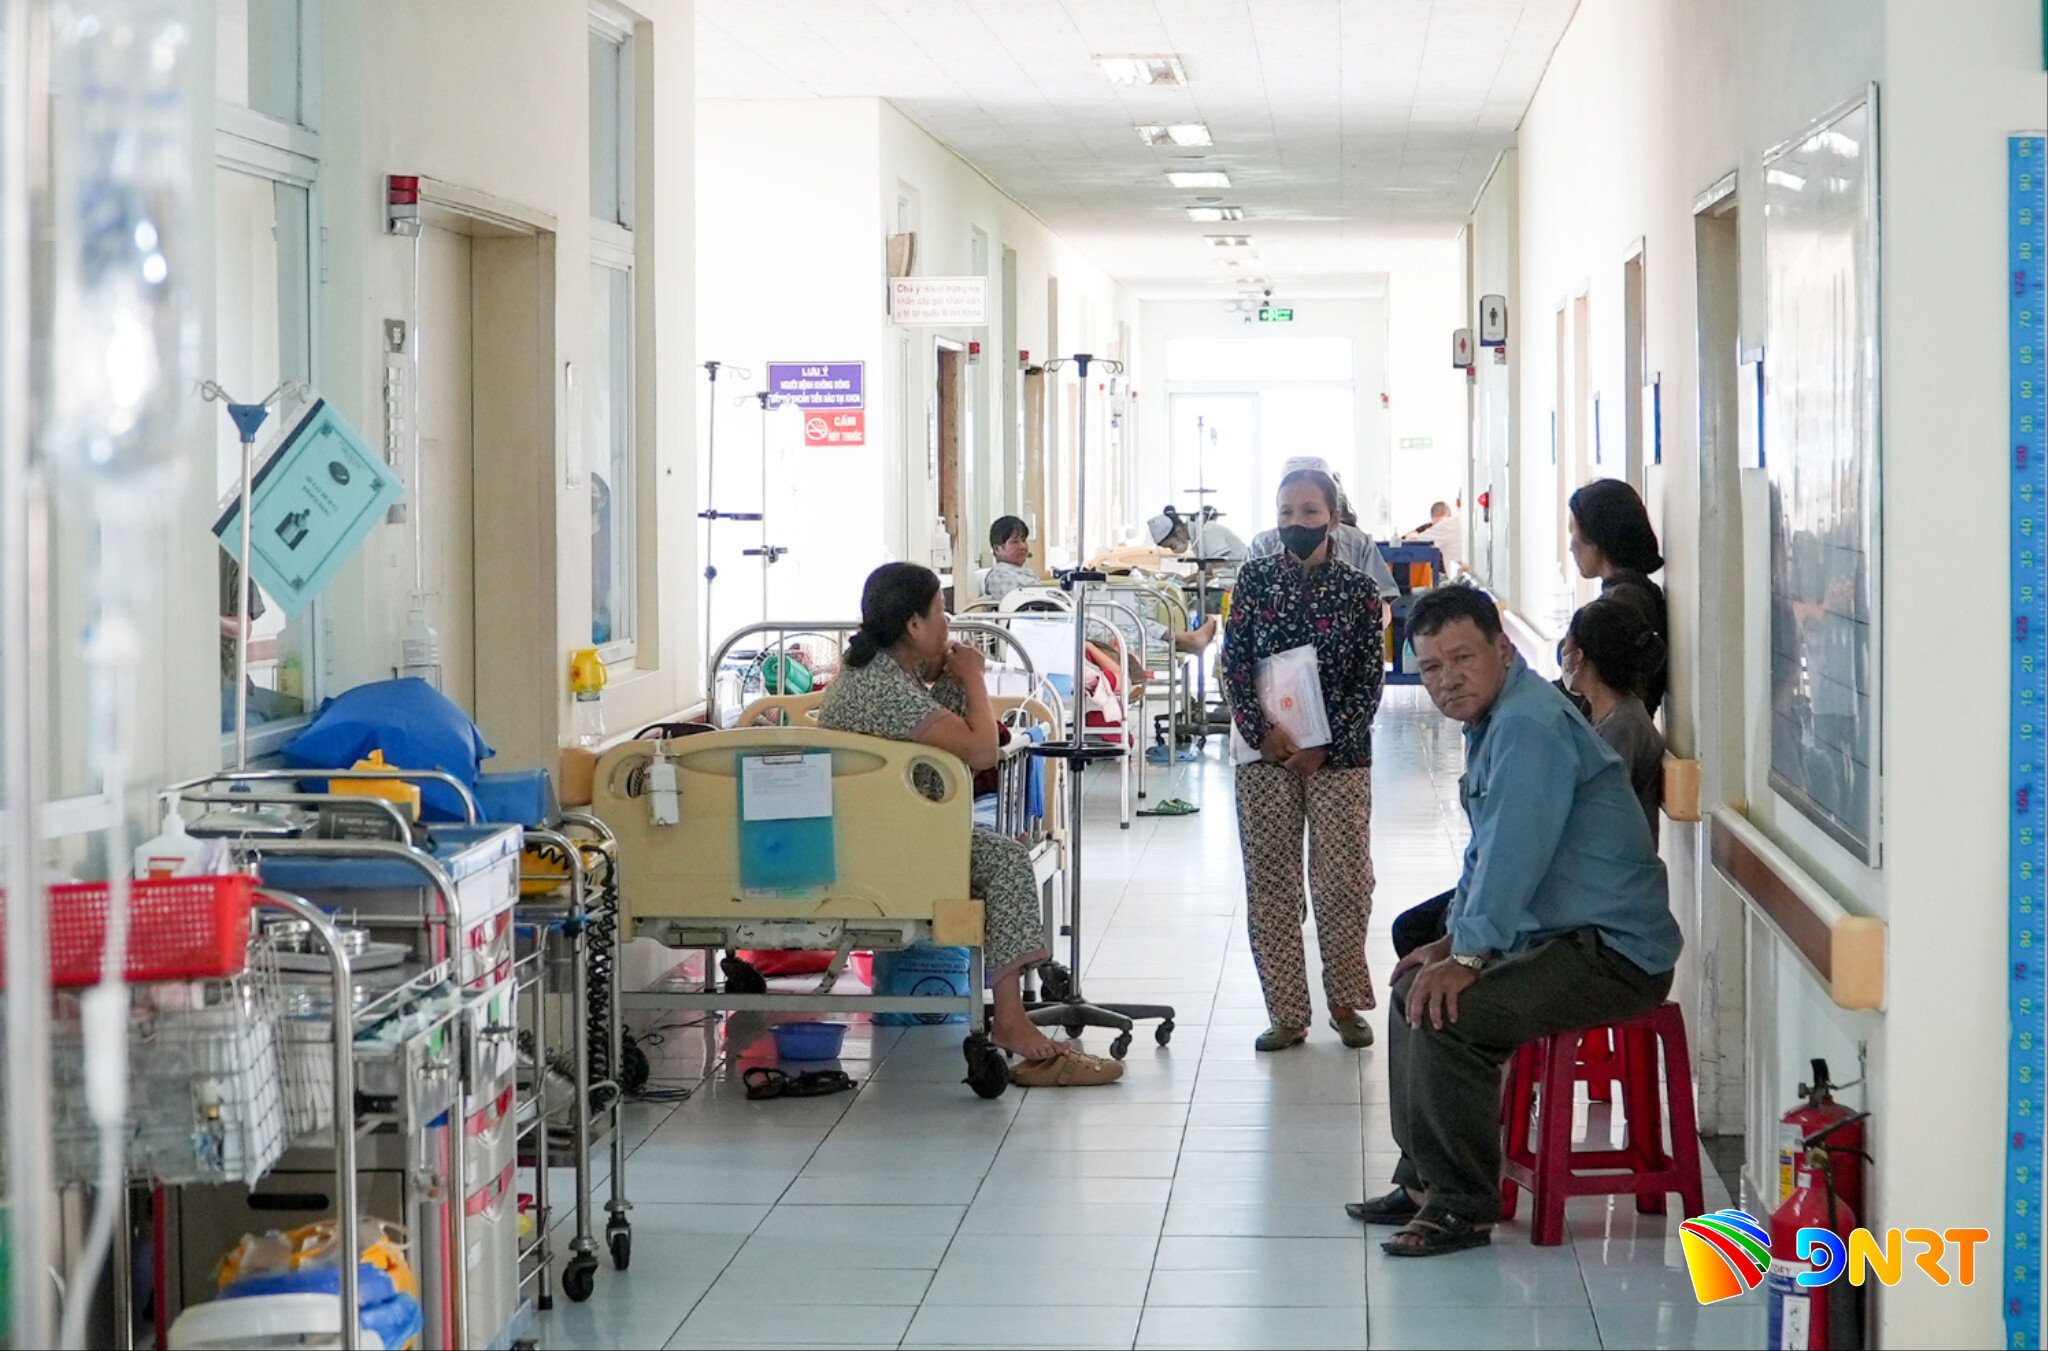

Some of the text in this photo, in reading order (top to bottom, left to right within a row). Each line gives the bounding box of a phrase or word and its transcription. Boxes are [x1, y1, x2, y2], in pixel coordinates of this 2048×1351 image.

[2020, 140, 2032, 158] 95
[2020, 174, 2032, 192] 90
[2020, 208, 2032, 226] 85
[2020, 242, 2032, 260] 80
[2015, 271, 2026, 297] 175
[2020, 311, 2032, 328] 70
[2020, 346, 2033, 364] 65
[2020, 381, 2033, 399] 60
[834, 413, 857, 427] CẤM
[2021, 416, 2033, 433] 55
[2016, 446, 2028, 471] 150
[2020, 484, 2033, 502] 45
[2020, 518, 2033, 536] 40
[2021, 550, 2034, 568] 35
[2021, 586, 2034, 603] 30
[2016, 617, 2028, 642] 125
[2021, 656, 2034, 673] 20
[2021, 690, 2034, 706] 15
[2020, 724, 2033, 741] 10
[2020, 763, 2032, 773] 5
[2016, 789, 2028, 814] 100
[2020, 827, 2032, 845] 95
[2020, 861, 2032, 879] 90
[2020, 896, 2032, 914] 85
[2020, 930, 2032, 948] 80
[2015, 964, 2027, 981] 75
[2020, 998, 2032, 1015] 70
[2020, 1032, 2032, 1050] 65
[2019, 1066, 2032, 1084] 60
[2019, 1100, 2031, 1117] 55
[2013, 1133, 2025, 1149] 50
[2017, 1166, 2029, 1184] 45
[2016, 1199, 2028, 1217] 40
[2016, 1232, 2027, 1250] 35
[2015, 1266, 2027, 1283] 30
[2009, 1299, 2021, 1315] 25
[2014, 1331, 2026, 1348] 20
